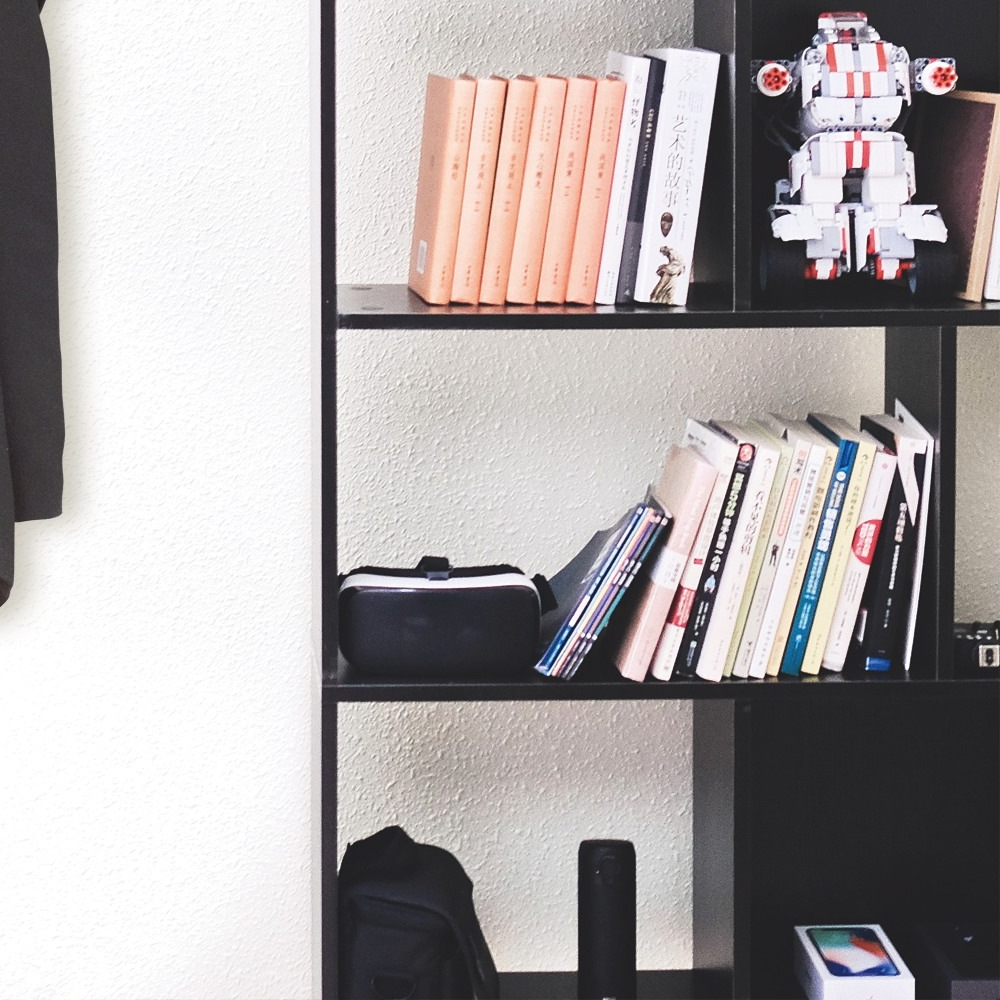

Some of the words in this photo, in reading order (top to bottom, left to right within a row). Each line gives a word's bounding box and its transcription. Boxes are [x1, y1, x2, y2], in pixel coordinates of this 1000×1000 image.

[664, 114, 688, 209] 艺术的故事
